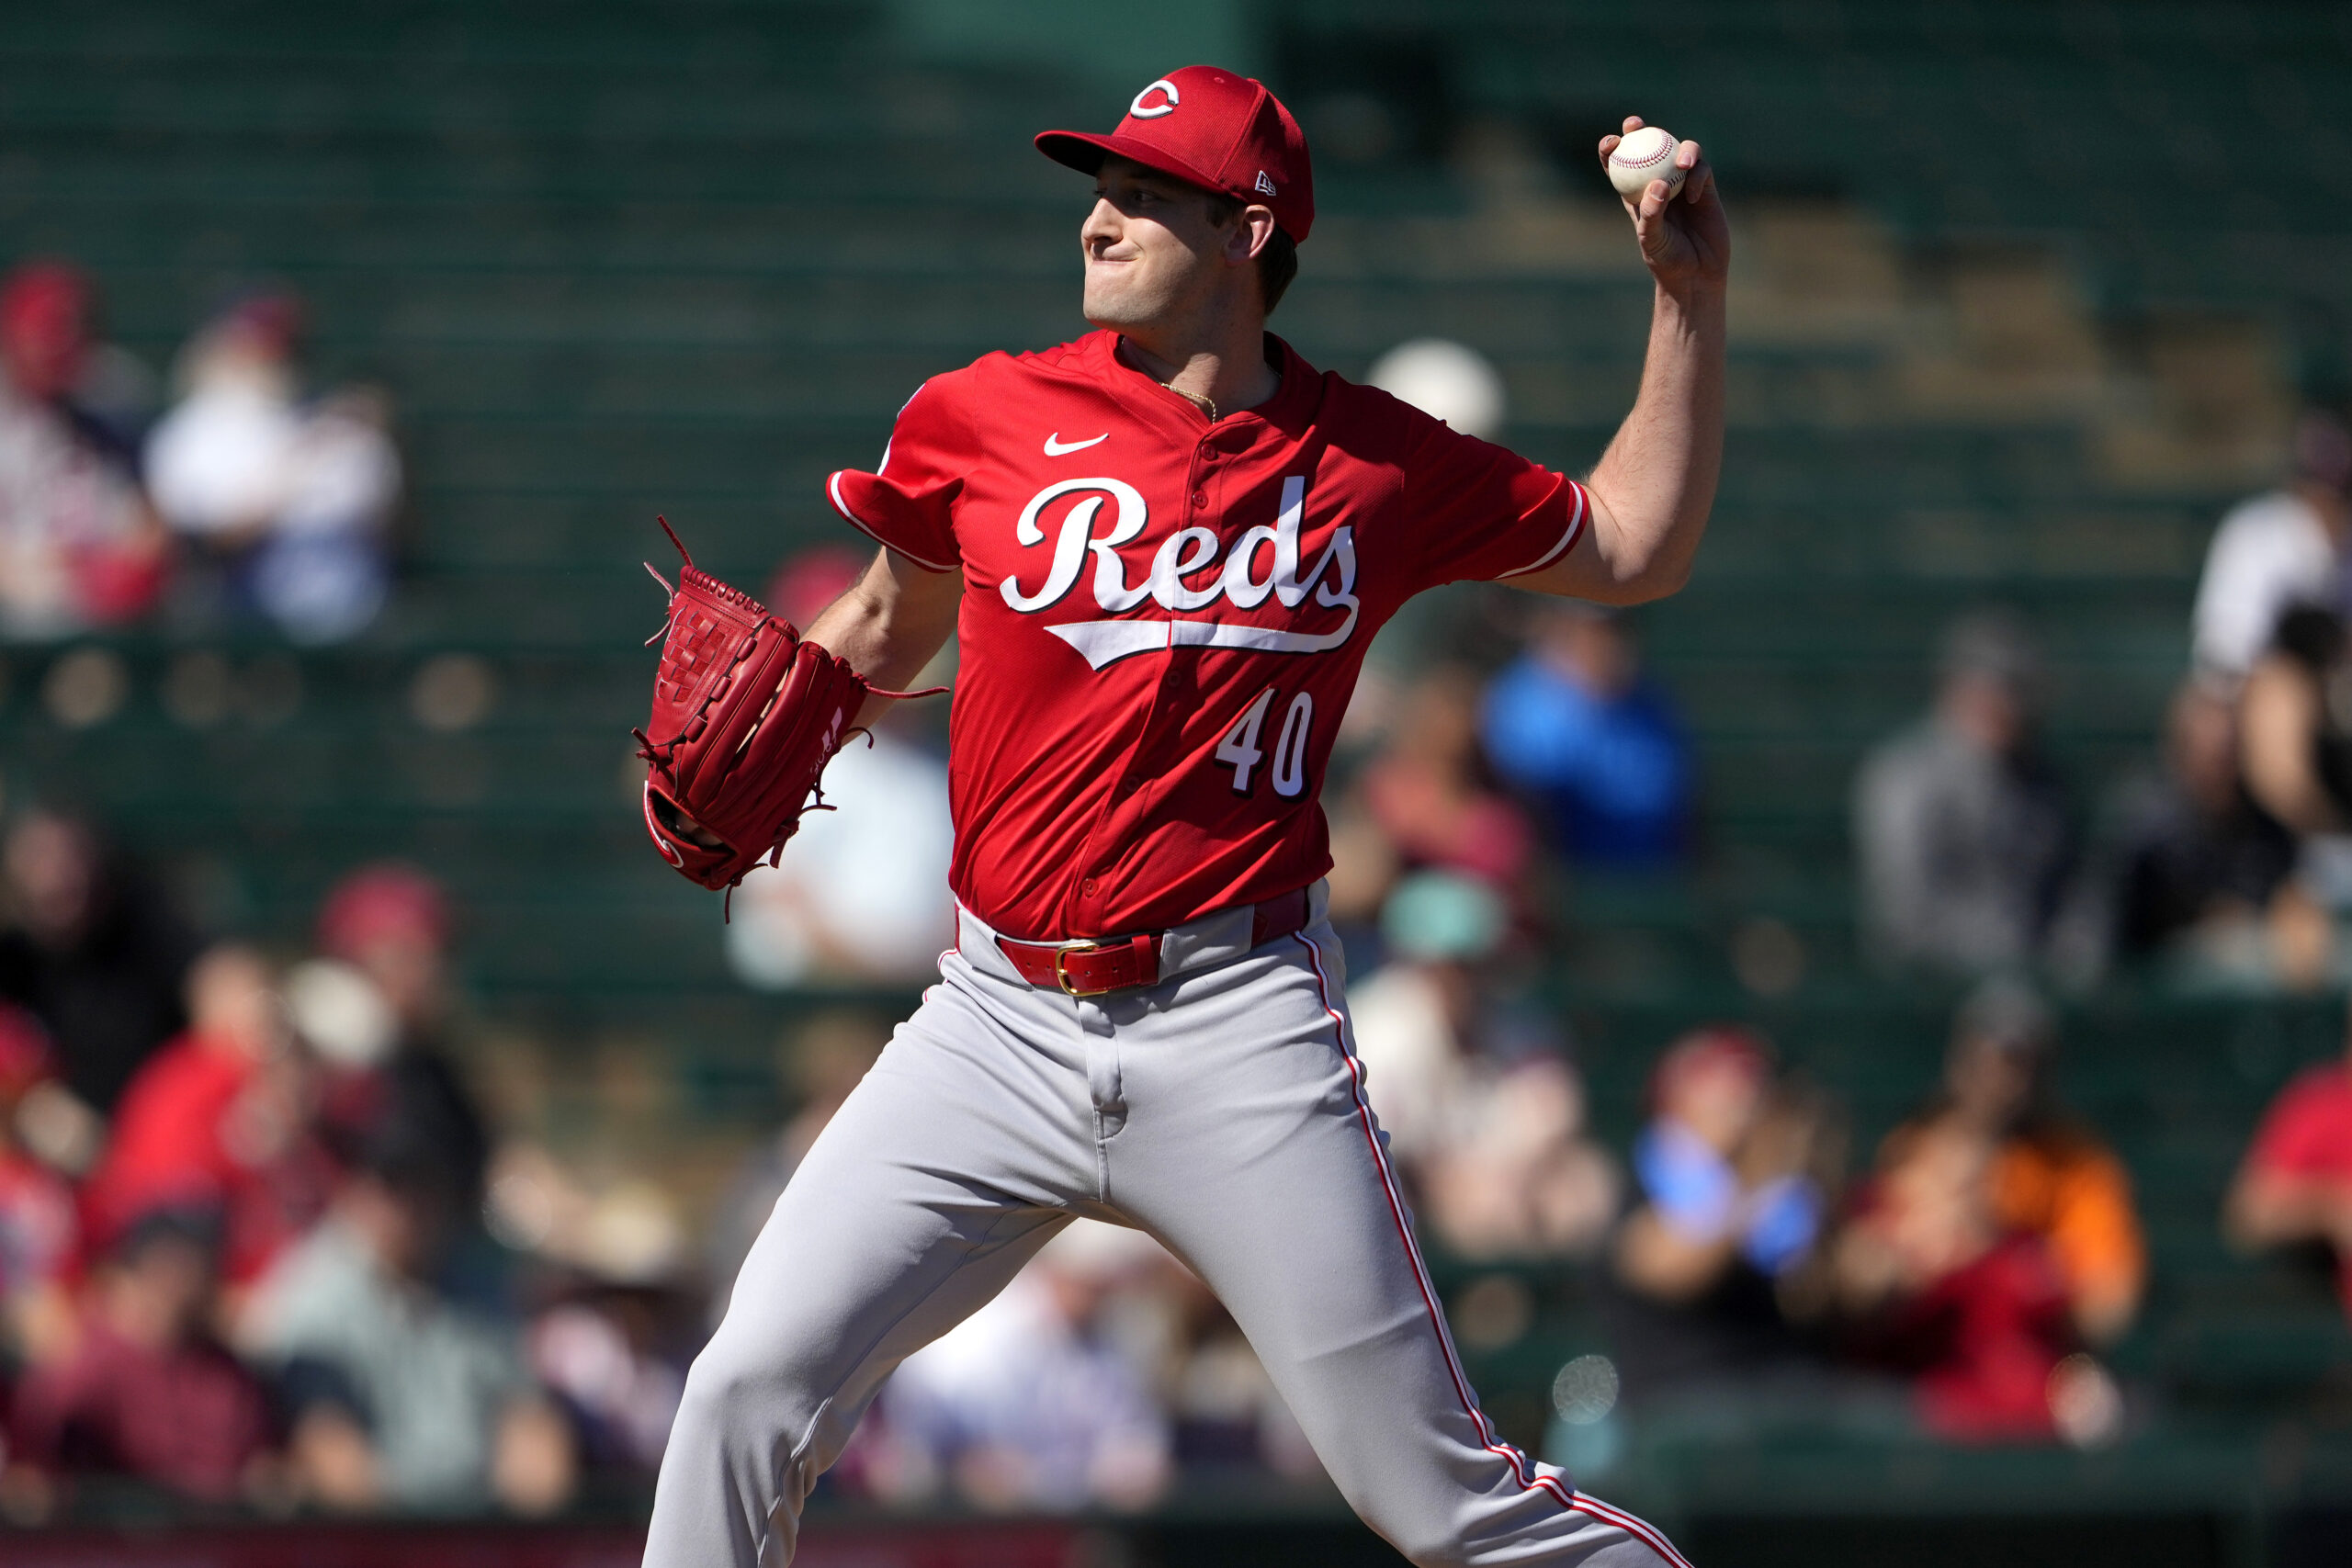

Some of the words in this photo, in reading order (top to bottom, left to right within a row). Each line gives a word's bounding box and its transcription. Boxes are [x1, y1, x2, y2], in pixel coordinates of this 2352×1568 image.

[1130, 80, 1180, 119] C
[1000, 475, 1360, 671] Reds
[1215, 687, 1310, 799] 40
